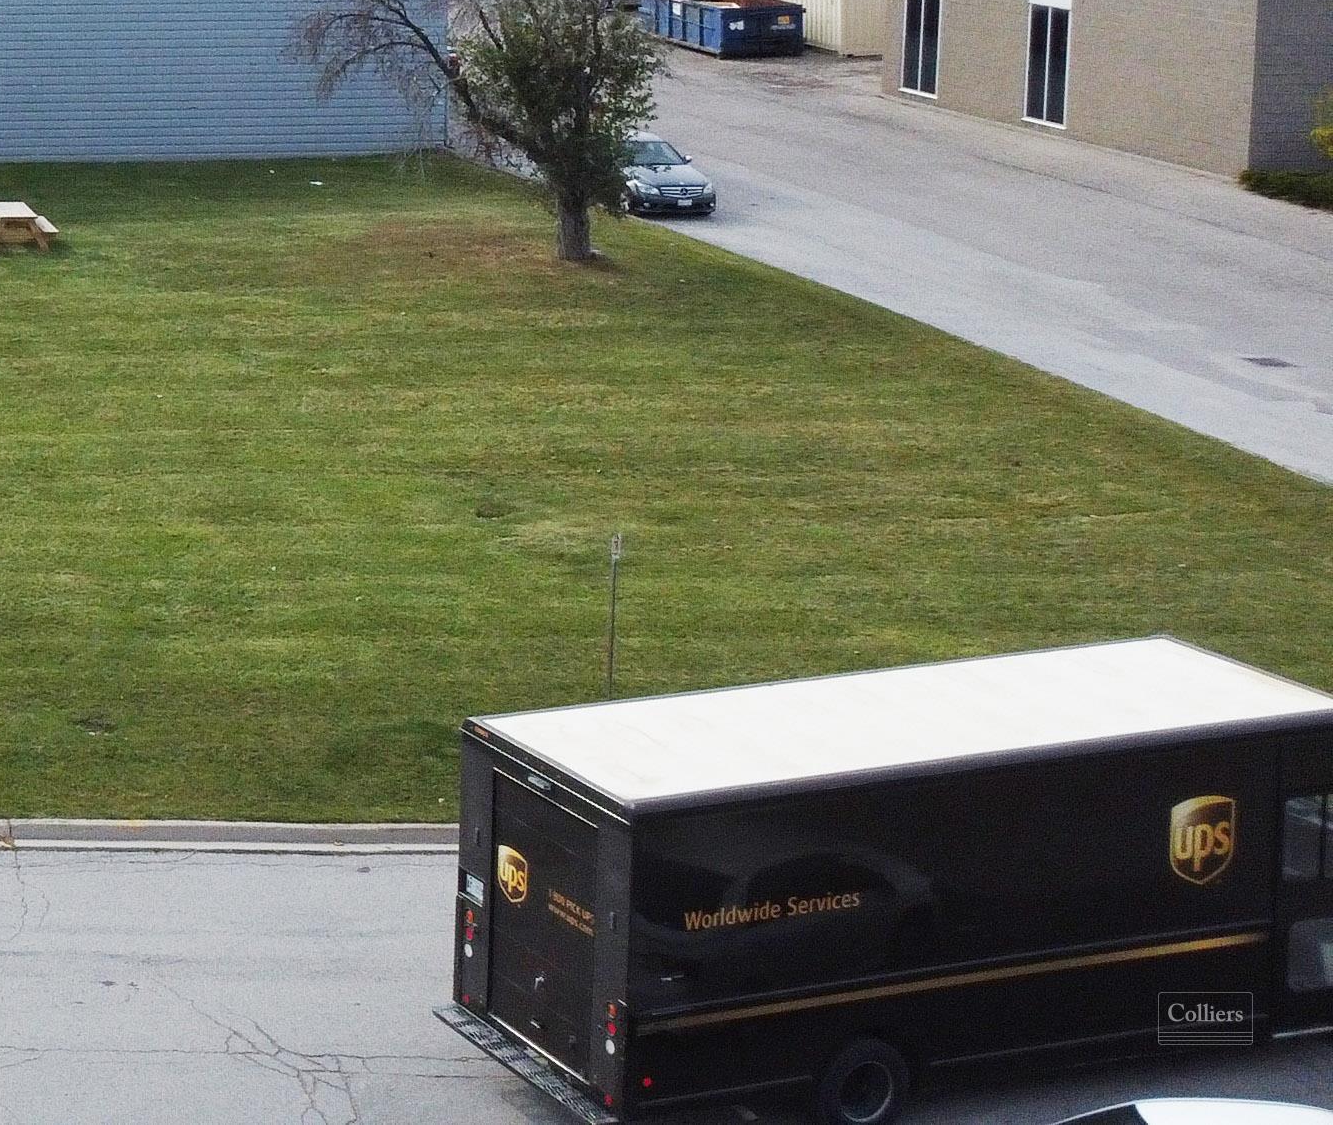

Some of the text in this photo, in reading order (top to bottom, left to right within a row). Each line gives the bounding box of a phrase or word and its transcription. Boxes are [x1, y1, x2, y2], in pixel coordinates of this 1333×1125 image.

[1173, 820, 1232, 872] ups
[499, 862, 526, 893] ups
[684, 891, 861, 931] Worldwide Services
